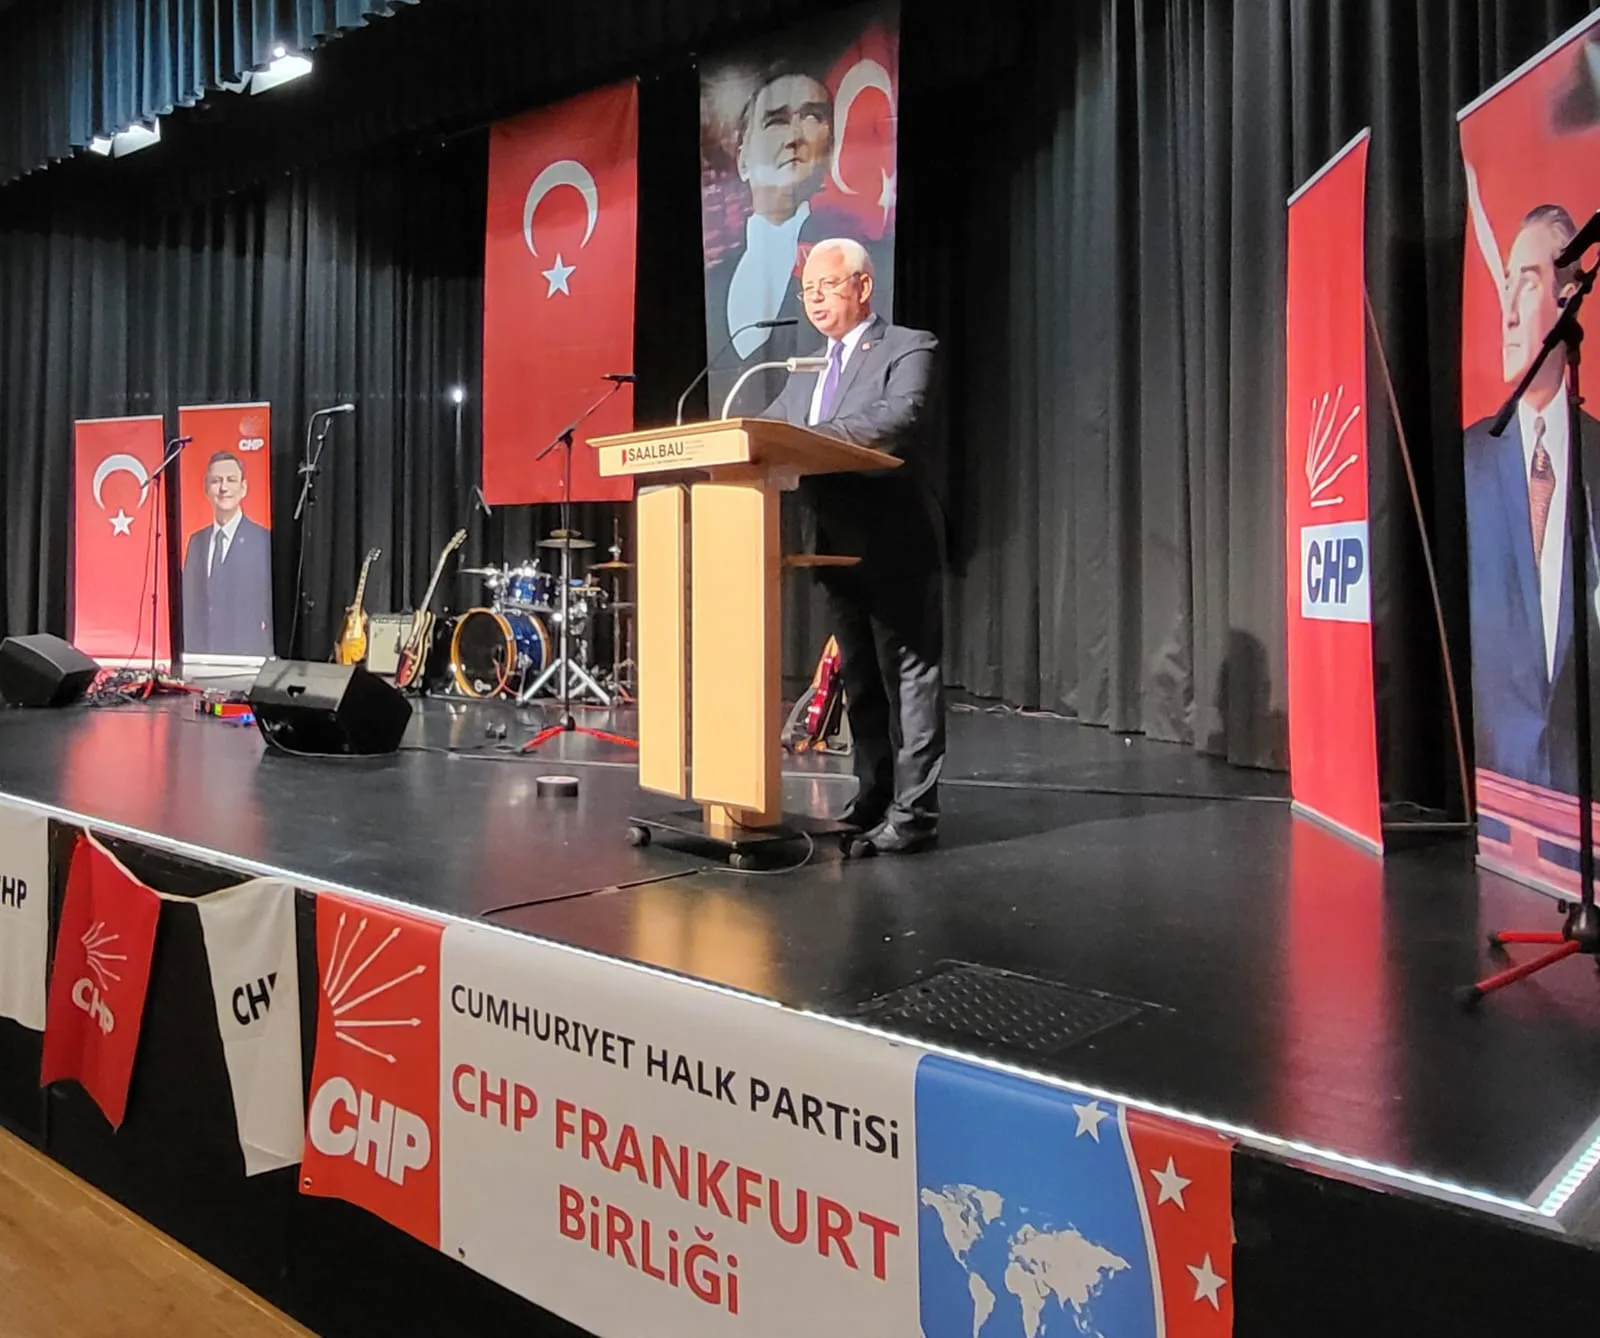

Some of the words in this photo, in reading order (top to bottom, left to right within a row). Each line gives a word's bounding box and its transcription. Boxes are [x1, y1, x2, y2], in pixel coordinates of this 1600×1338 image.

[628, 441, 684, 462] SAALBAU
[1307, 538, 1363, 604] CHP
[0, 875, 27, 909] HP
[72, 977, 115, 1036] CHP
[451, 984, 635, 1069] CUMHURIYET
[646, 1044, 737, 1105] HALK
[309, 1076, 432, 1186] CHP
[452, 1063, 539, 1133] CHP
[555, 1098, 901, 1282] FRANKFURT
